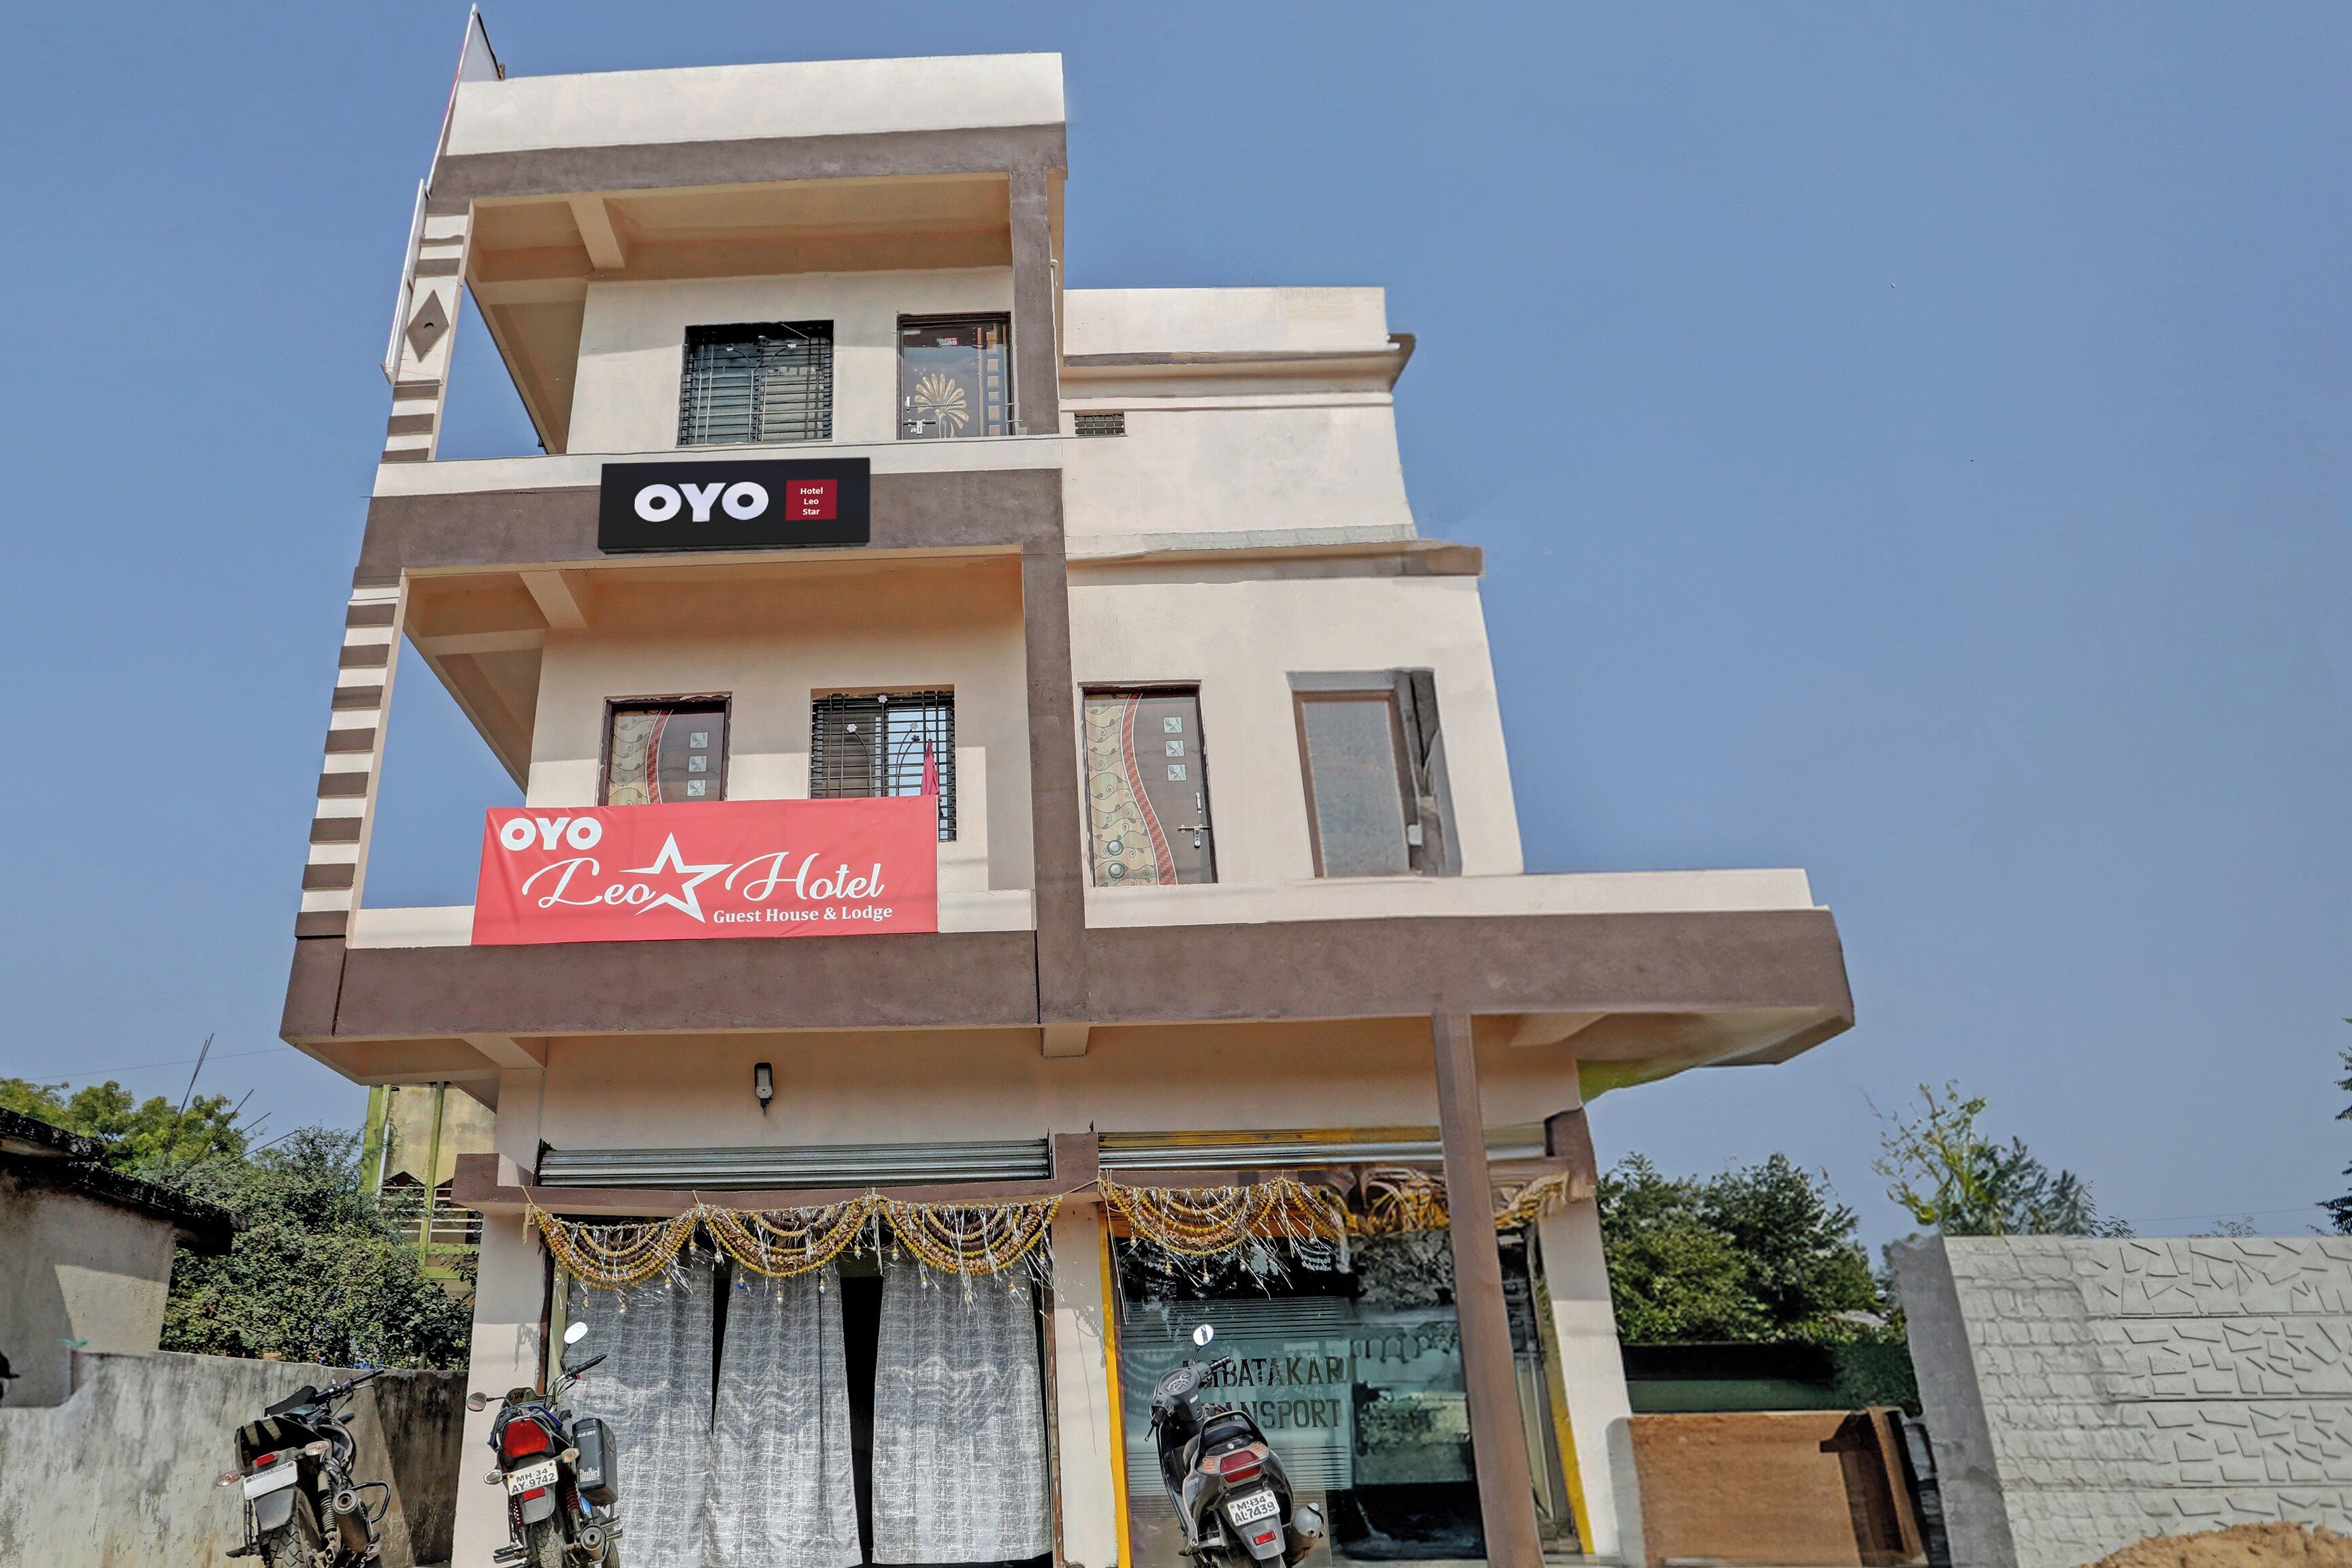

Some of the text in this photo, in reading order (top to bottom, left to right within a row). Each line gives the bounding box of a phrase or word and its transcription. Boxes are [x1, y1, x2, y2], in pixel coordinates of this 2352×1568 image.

[634, 481, 769, 523] OYO
[800, 487, 823, 495] Hotel
[500, 817, 602, 851] OYO
[521, 851, 885, 909] Leo Hotel
[713, 904, 893, 924] Guest House & Lodge
[1182, 1356, 1346, 1388] BATAKAR
[1200, 1399, 1340, 1429] NSPORT
